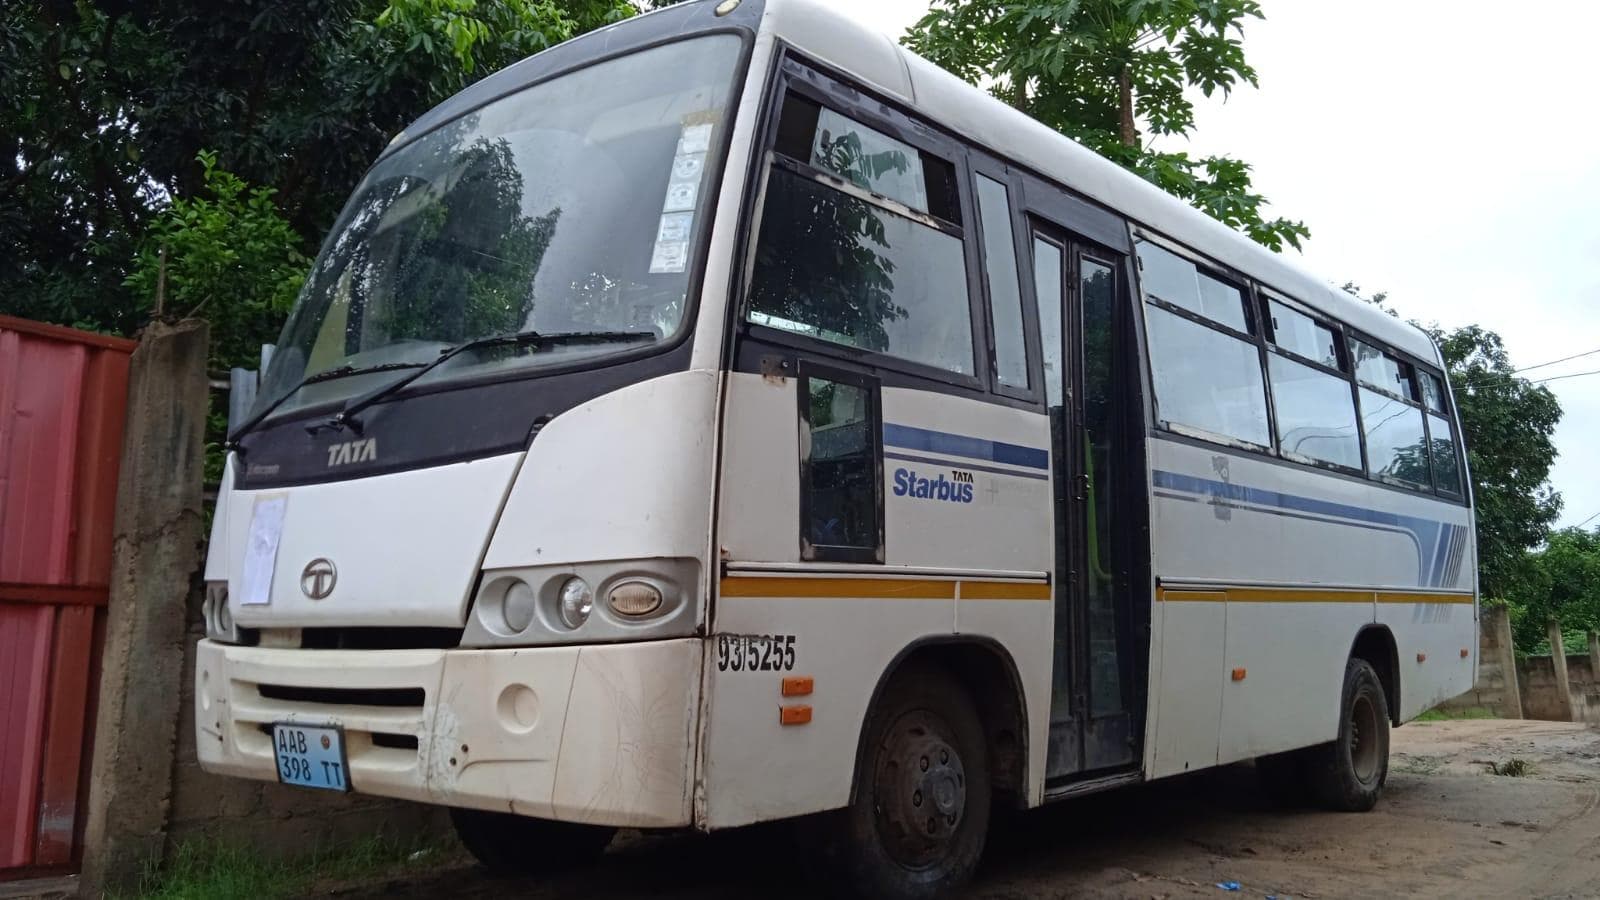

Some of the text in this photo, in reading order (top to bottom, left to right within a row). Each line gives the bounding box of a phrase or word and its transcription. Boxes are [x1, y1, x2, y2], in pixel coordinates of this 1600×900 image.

[328, 438, 377, 467] TATA
[893, 468, 973, 504] Starbus
[952, 471, 974, 483] TATA
[718, 634, 796, 671] 93/5255
[280, 729, 307, 754] AAB
[281, 755, 341, 786] 398 TT
